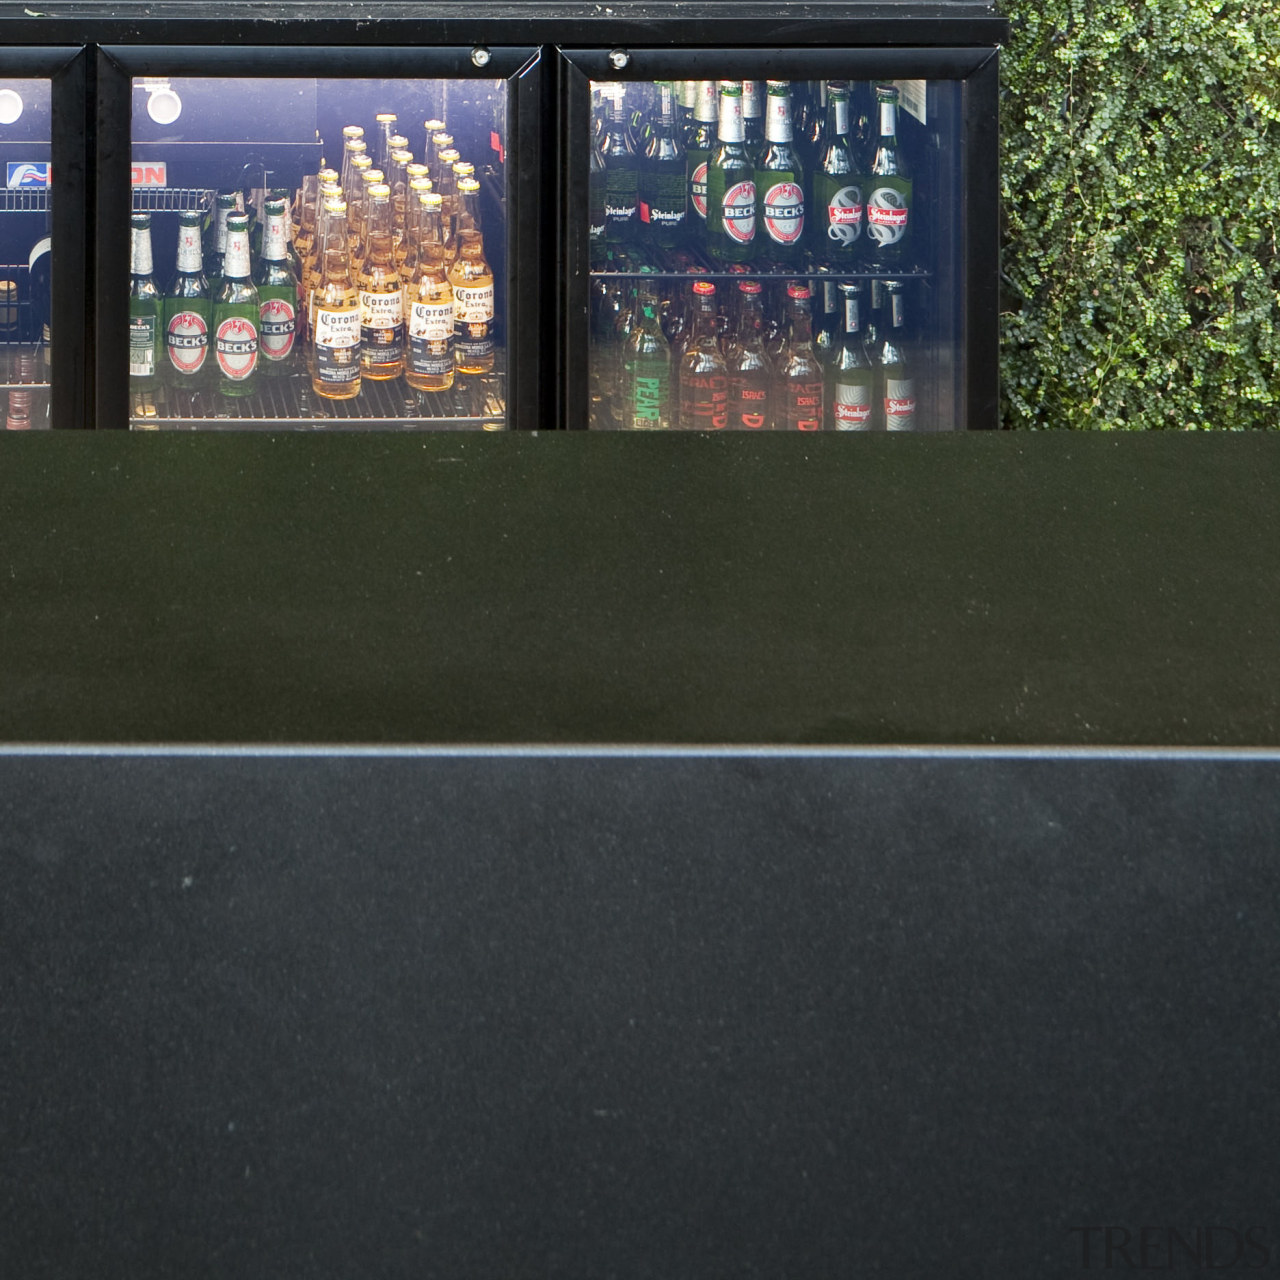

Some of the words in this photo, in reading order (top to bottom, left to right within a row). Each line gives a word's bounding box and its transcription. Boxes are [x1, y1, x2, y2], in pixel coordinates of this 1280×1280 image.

[765, 205, 804, 217] BECK'S
[362, 294, 400, 307] Corona
[456, 289, 493, 301] Corona
[169, 335, 208, 346] BECK'S
[217, 340, 258, 352] BECK'S
[636, 377, 659, 421] PEAR
